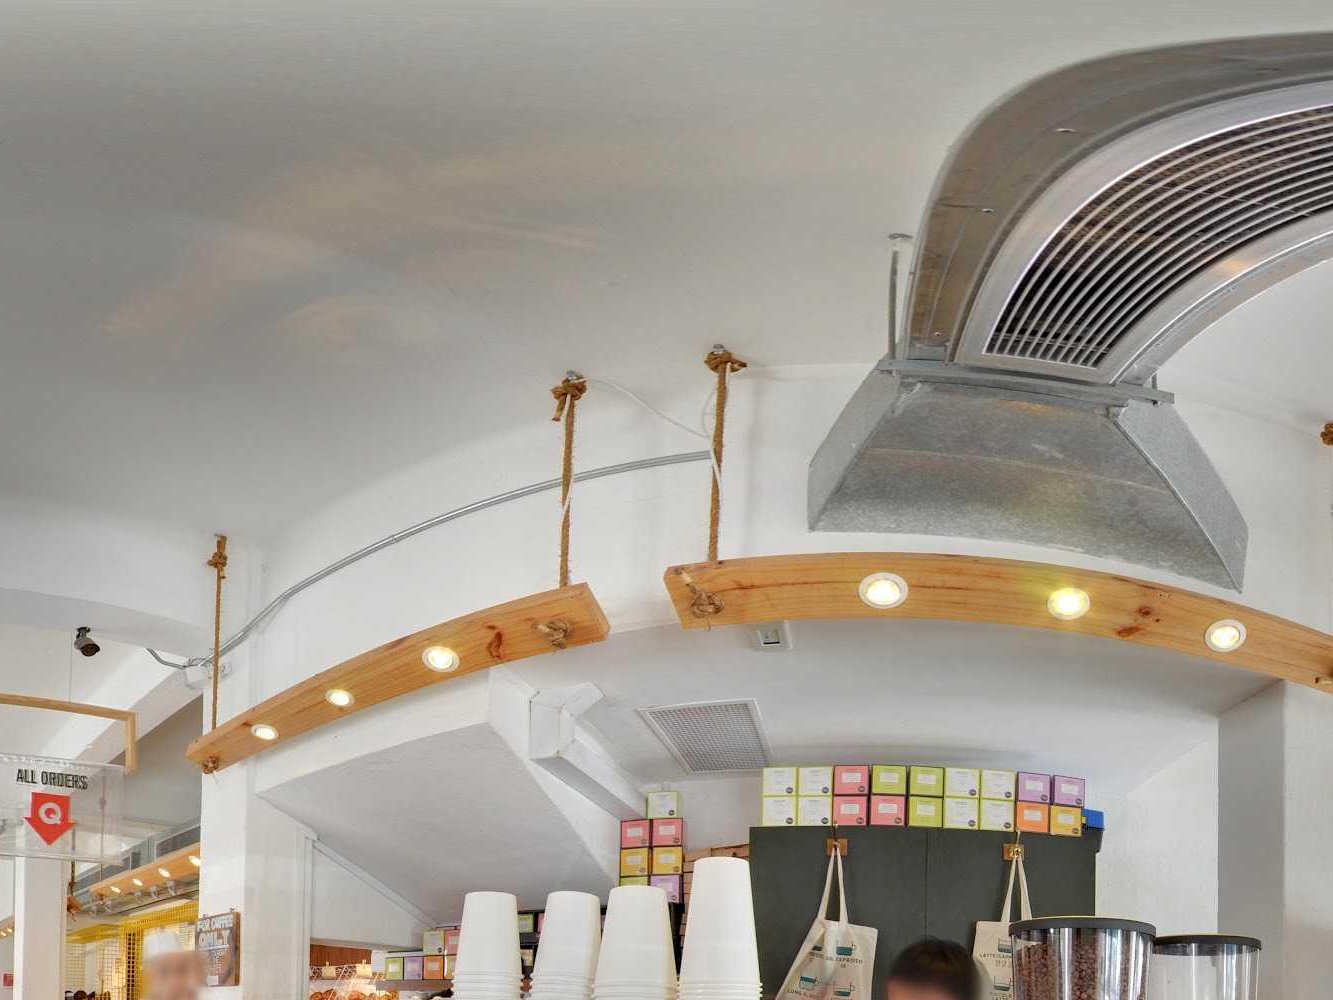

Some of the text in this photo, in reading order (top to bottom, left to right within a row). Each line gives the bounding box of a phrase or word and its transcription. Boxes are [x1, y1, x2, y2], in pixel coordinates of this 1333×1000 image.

[16, 769, 88, 789] ALL ORDERS
[38, 802, 61, 825] Q
[197, 915, 233, 932] FOR COFFEE
[199, 930, 230, 947] ONLY
[836, 956, 862, 964] ESPRESSO
